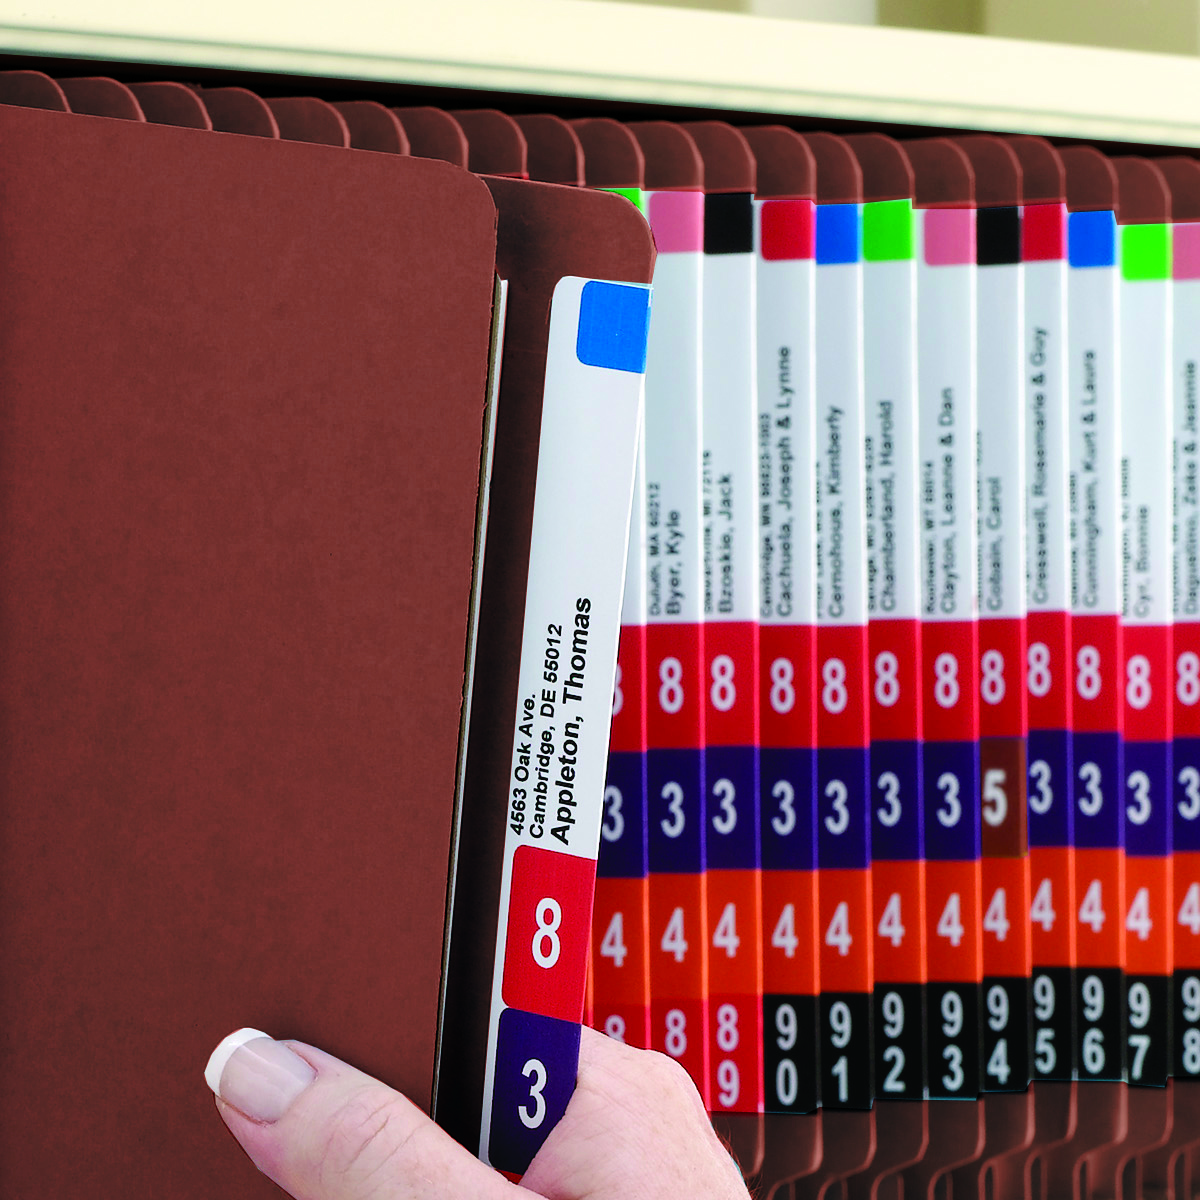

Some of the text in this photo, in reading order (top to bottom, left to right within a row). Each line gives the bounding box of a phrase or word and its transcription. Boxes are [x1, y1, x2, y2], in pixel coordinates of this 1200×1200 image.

[776, 347, 794, 408] Lynne
[939, 388, 953, 426] Dan
[776, 416, 790, 428] &
[826, 406, 843, 495] Kimberly
[879, 401, 892, 466] Harold
[718, 475, 732, 520] Jack
[777, 437, 794, 510] Joseph
[666, 511, 684, 615] Byer, Kyle
[771, 658, 795, 713] 8
[529, 623, 563, 839] Cambridge, DE 55012
[549, 597, 592, 846] Appleton, Thomas
[509, 694, 536, 836] 4563 Oak Ave.
[773, 781, 796, 835] 3
[532, 898, 561, 968] 8
[772, 904, 798, 957] 4
[518, 1059, 547, 1129] 3
